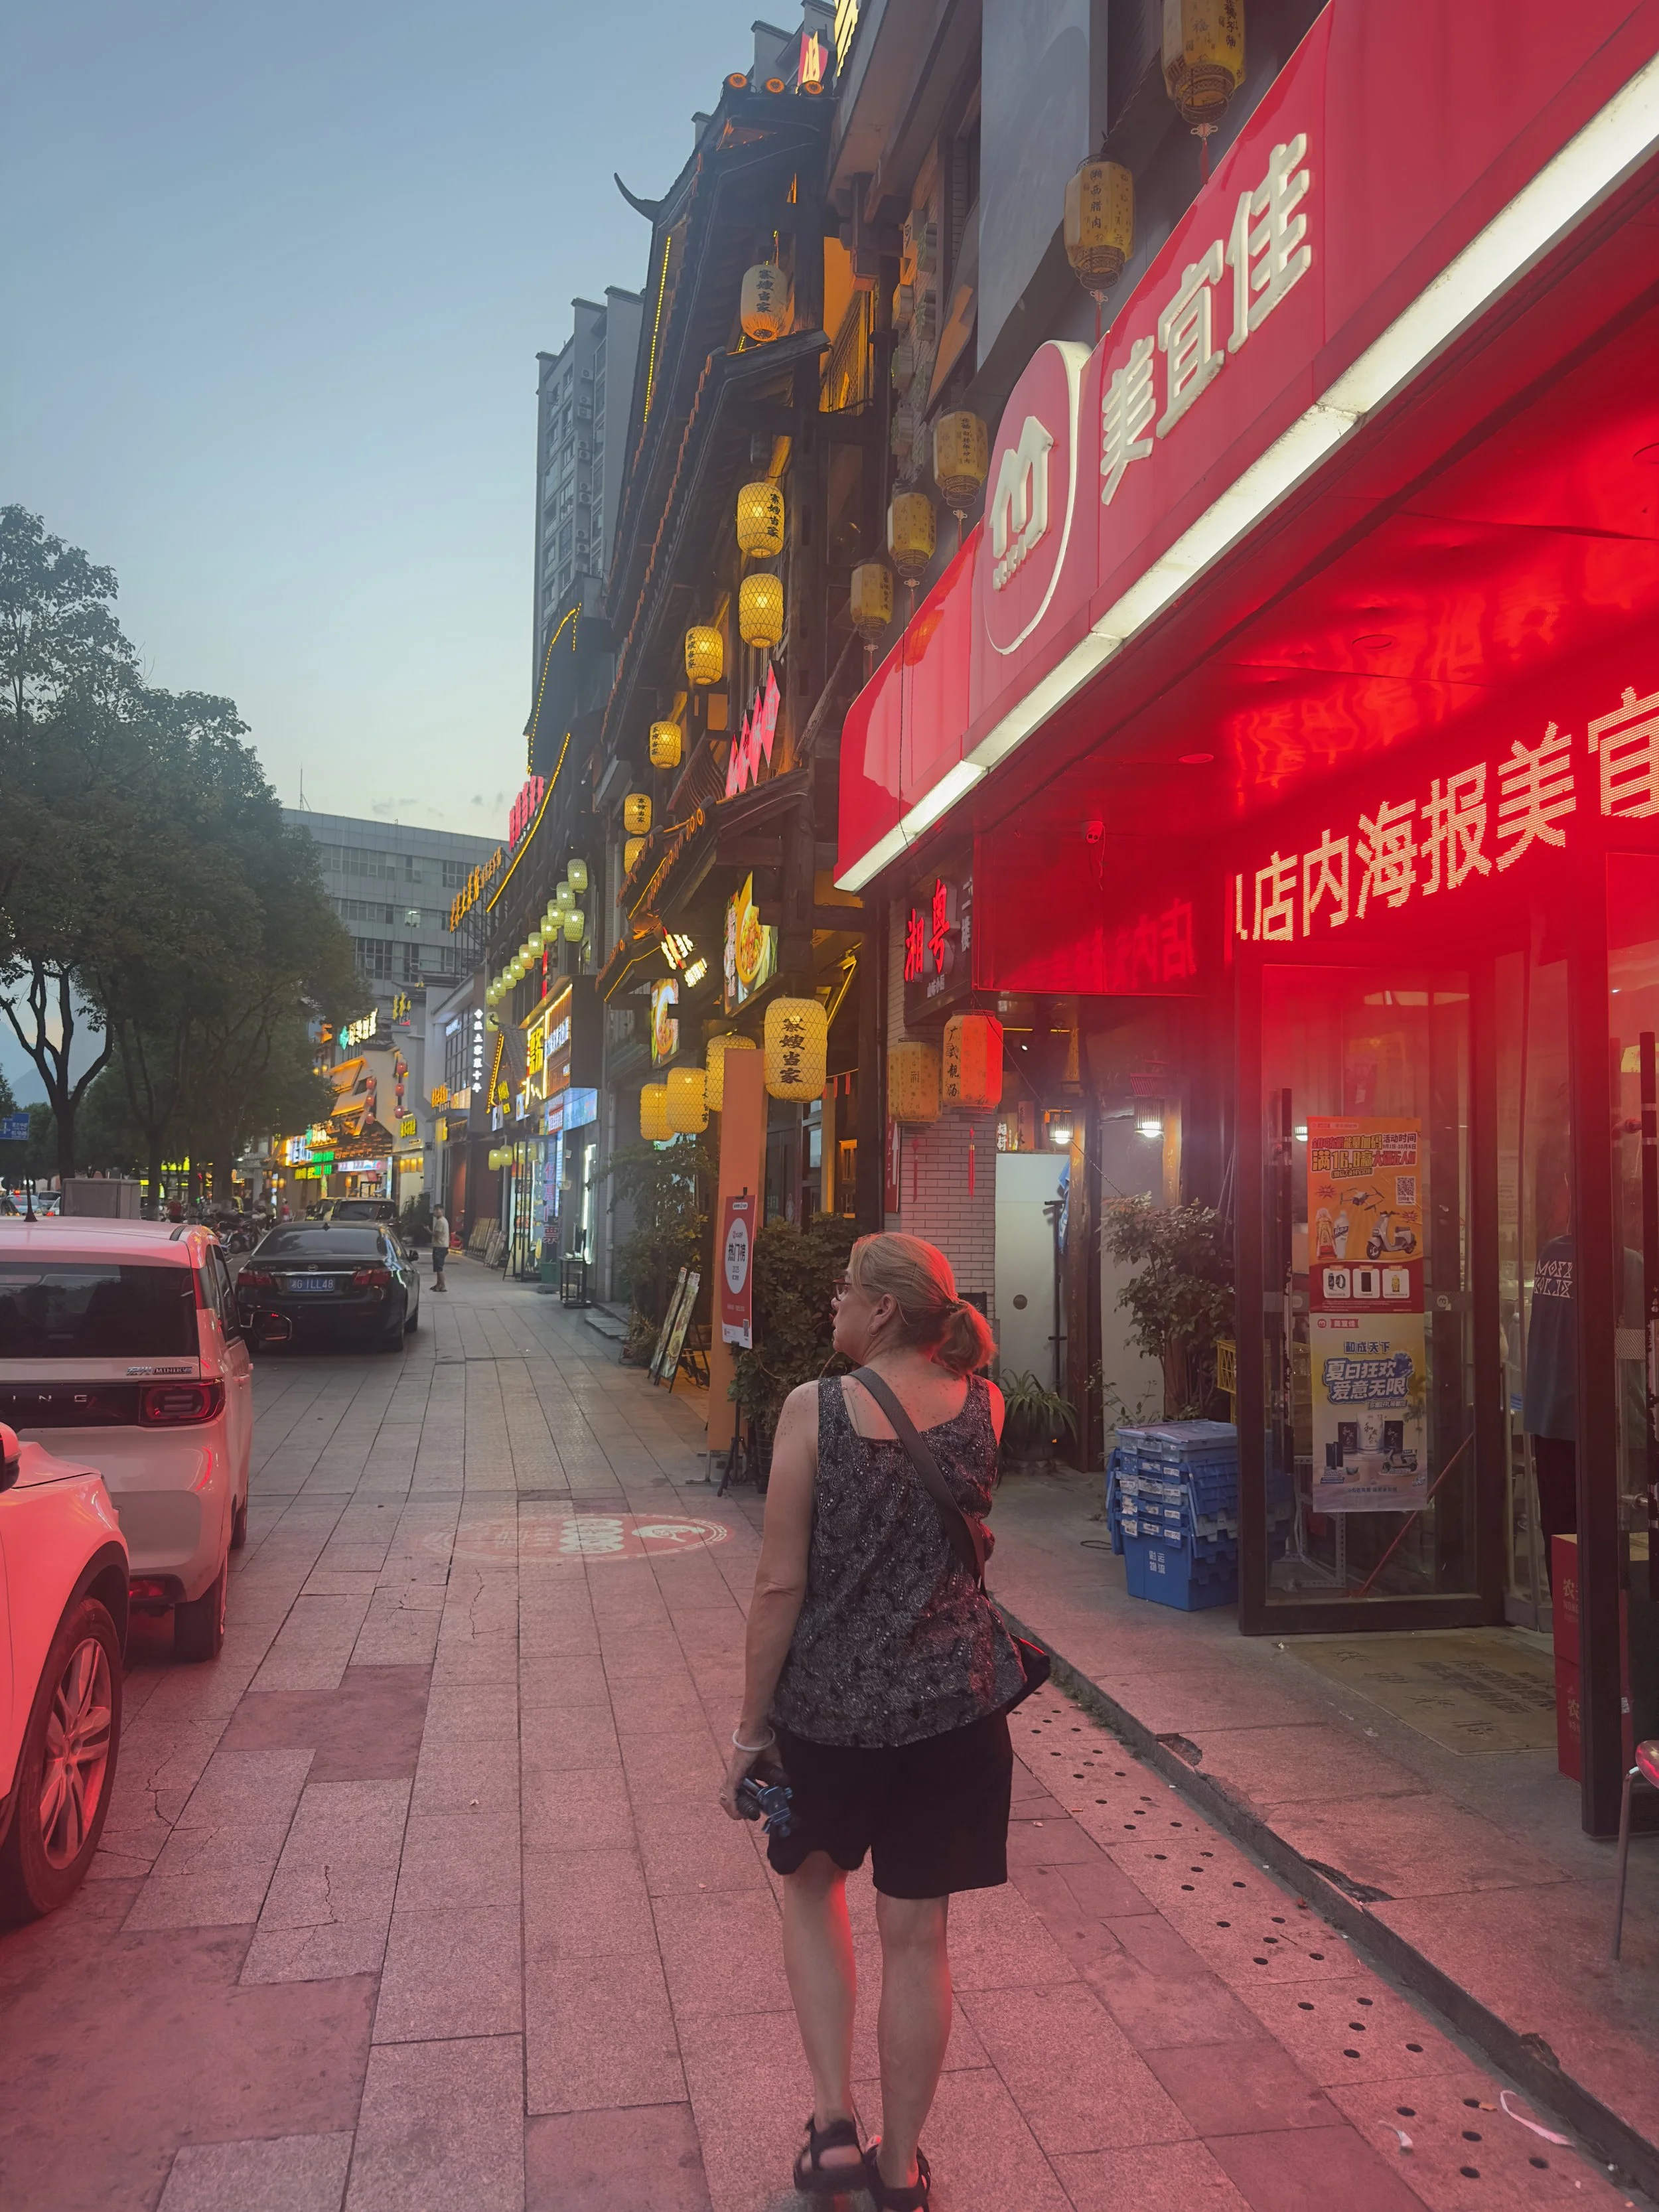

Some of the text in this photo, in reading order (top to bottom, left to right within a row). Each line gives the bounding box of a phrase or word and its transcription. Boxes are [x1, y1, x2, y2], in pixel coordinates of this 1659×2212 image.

[1100, 133, 1311, 506] 美宜佳
[779, 1018, 807, 1084] 寨嫂当家
[1383, 1134, 1416, 1143] 活动时间
[1344, 1341, 1391, 1353] 和成天下
[1326, 1361, 1397, 1382] 夏日狂欢
[1331, 1377, 1406, 1400] 爱意无限
